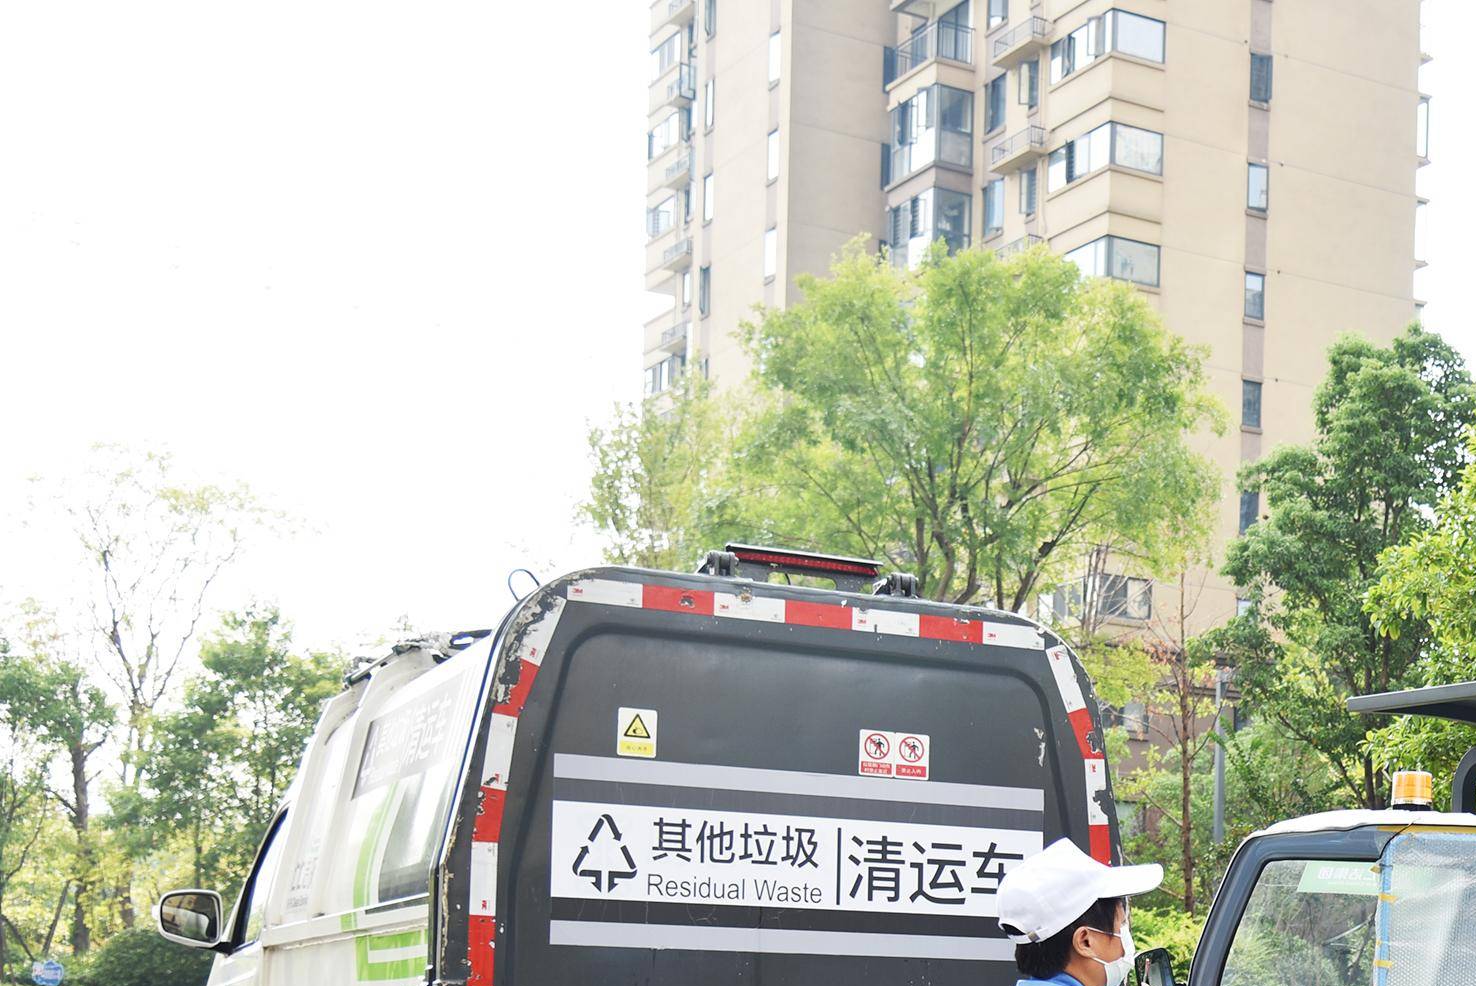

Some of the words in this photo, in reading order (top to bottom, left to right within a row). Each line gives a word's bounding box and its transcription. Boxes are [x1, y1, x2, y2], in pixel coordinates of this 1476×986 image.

[652, 816, 820, 869] 其他垃圾
[647, 872, 746, 901] Residual
[753, 878, 823, 904] Waste
[848, 834, 1024, 906] 清运车
